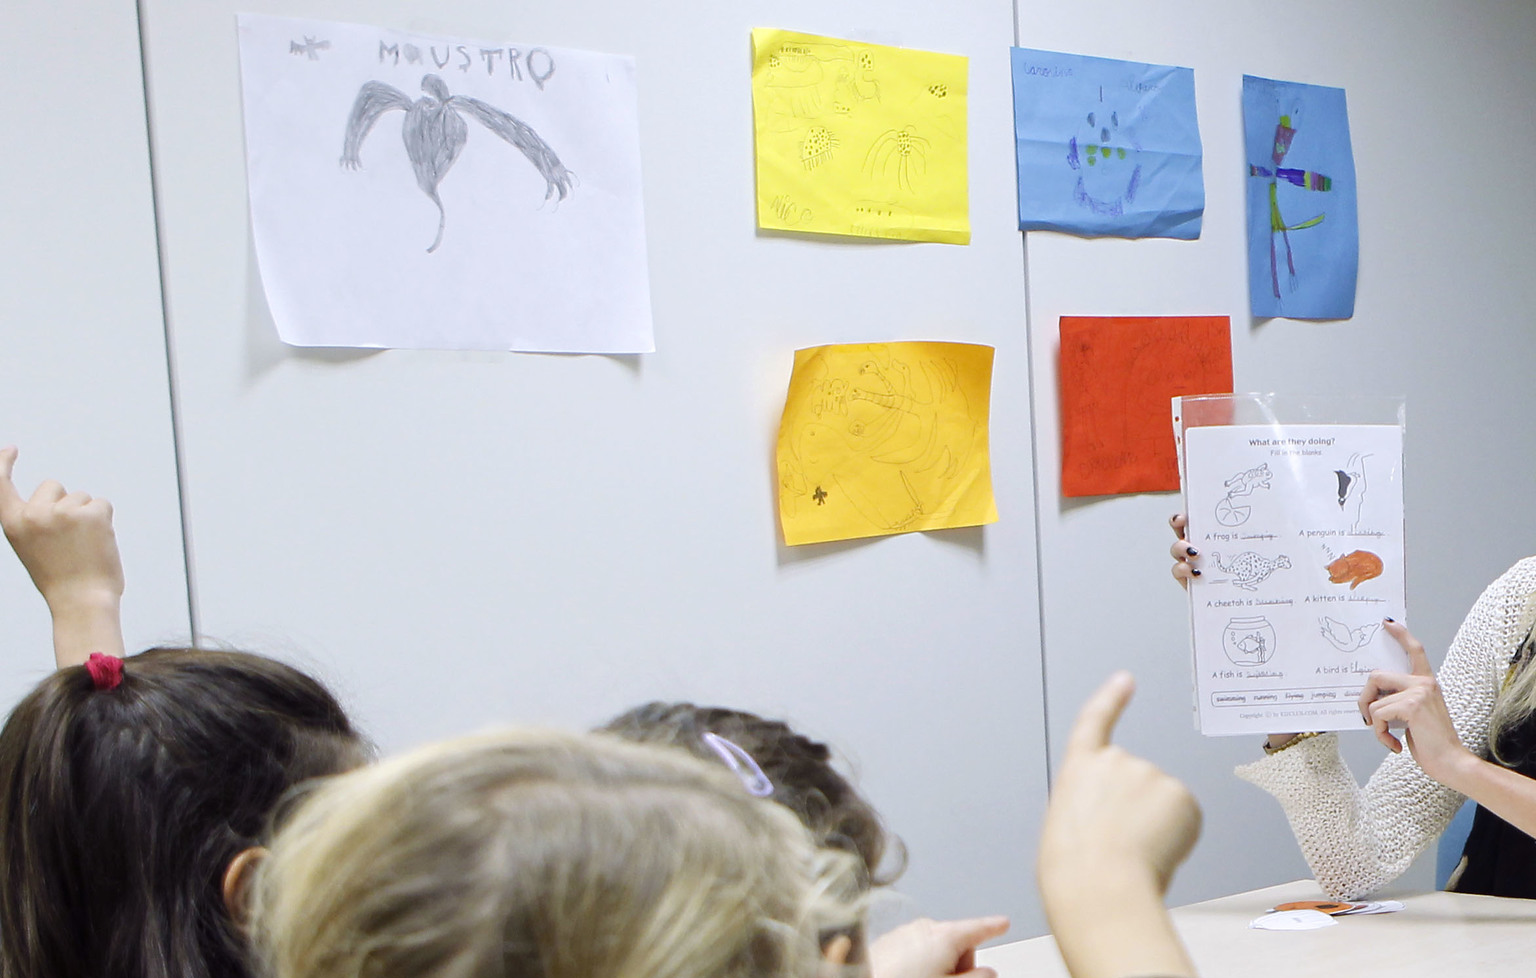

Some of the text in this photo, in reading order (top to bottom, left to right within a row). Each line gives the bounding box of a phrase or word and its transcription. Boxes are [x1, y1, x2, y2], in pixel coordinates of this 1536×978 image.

[1248, 438, 1270, 446] What
[1287, 438, 1306, 446] they
[1308, 437, 1336, 446] doing?
[1213, 532, 1230, 542] frog
[1231, 532, 1239, 540] is
[1307, 529, 1337, 538] penguin
[1338, 528, 1345, 536] is
[1312, 594, 1337, 602] kitten
[1214, 599, 1244, 607] cheetah
[1323, 665, 1340, 674] bird
[1341, 665, 1348, 673] is
[1211, 671, 1218, 679] A
[1219, 670, 1235, 679] fish
[1236, 670, 1243, 678] is
